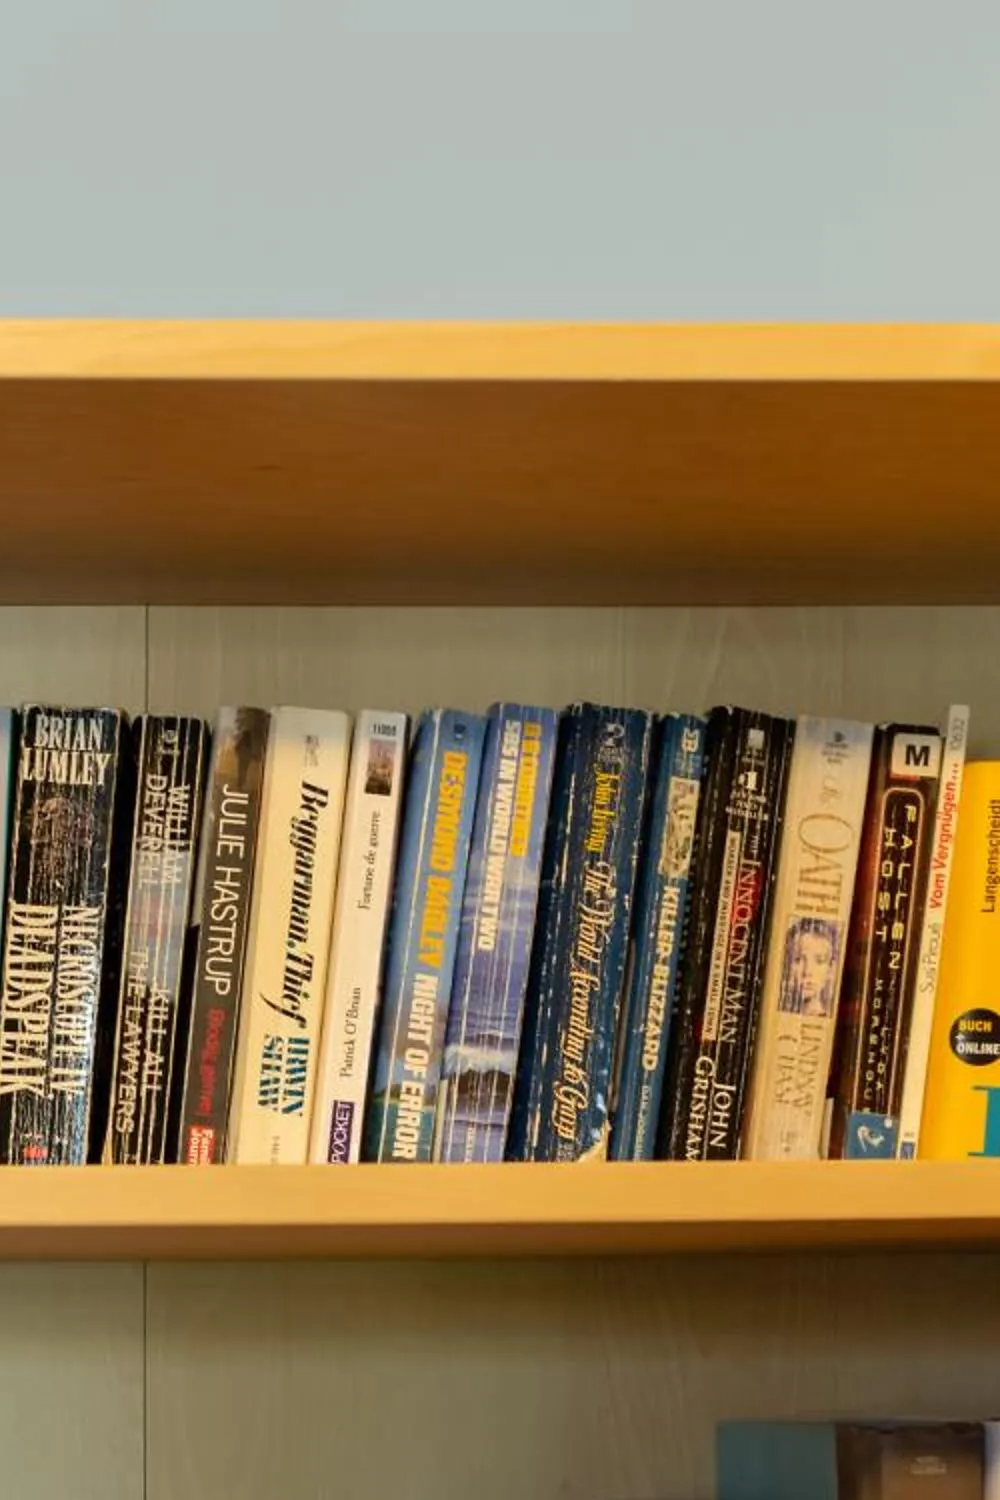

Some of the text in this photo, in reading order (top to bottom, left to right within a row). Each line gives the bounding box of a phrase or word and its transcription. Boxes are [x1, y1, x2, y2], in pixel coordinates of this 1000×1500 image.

[23, 746, 112, 785] LUMLEY
[34, 713, 104, 750] BRIAN
[905, 744, 930, 767] M
[138, 774, 168, 890] DEVERELL
[160, 784, 190, 885] WILLIAM
[417, 750, 469, 968] DESMOND BAGLEY
[795, 812, 856, 916] OATH
[204, 783, 249, 996] JULIE HASTRUP
[873, 827, 898, 943] HOST
[888, 802, 919, 972] FALLEN
[929, 873, 947, 910] Vom
[53, 904, 101, 1063] NECROSCOPE
[959, 1020, 992, 1032] BUCH
[115, 948, 149, 1134] THE LAWYERS
[140, 982, 171, 1098] KILL ALL
[257, 1033, 285, 1112] SHAW
[281, 1033, 311, 1117] IRWIN
[392, 973, 440, 1160] NIGHT OF ERROR
[956, 1042, 1000, 1055] ONLINE
[331, 1102, 352, 1164] POCKET
[707, 1082, 738, 1149] JOHN
